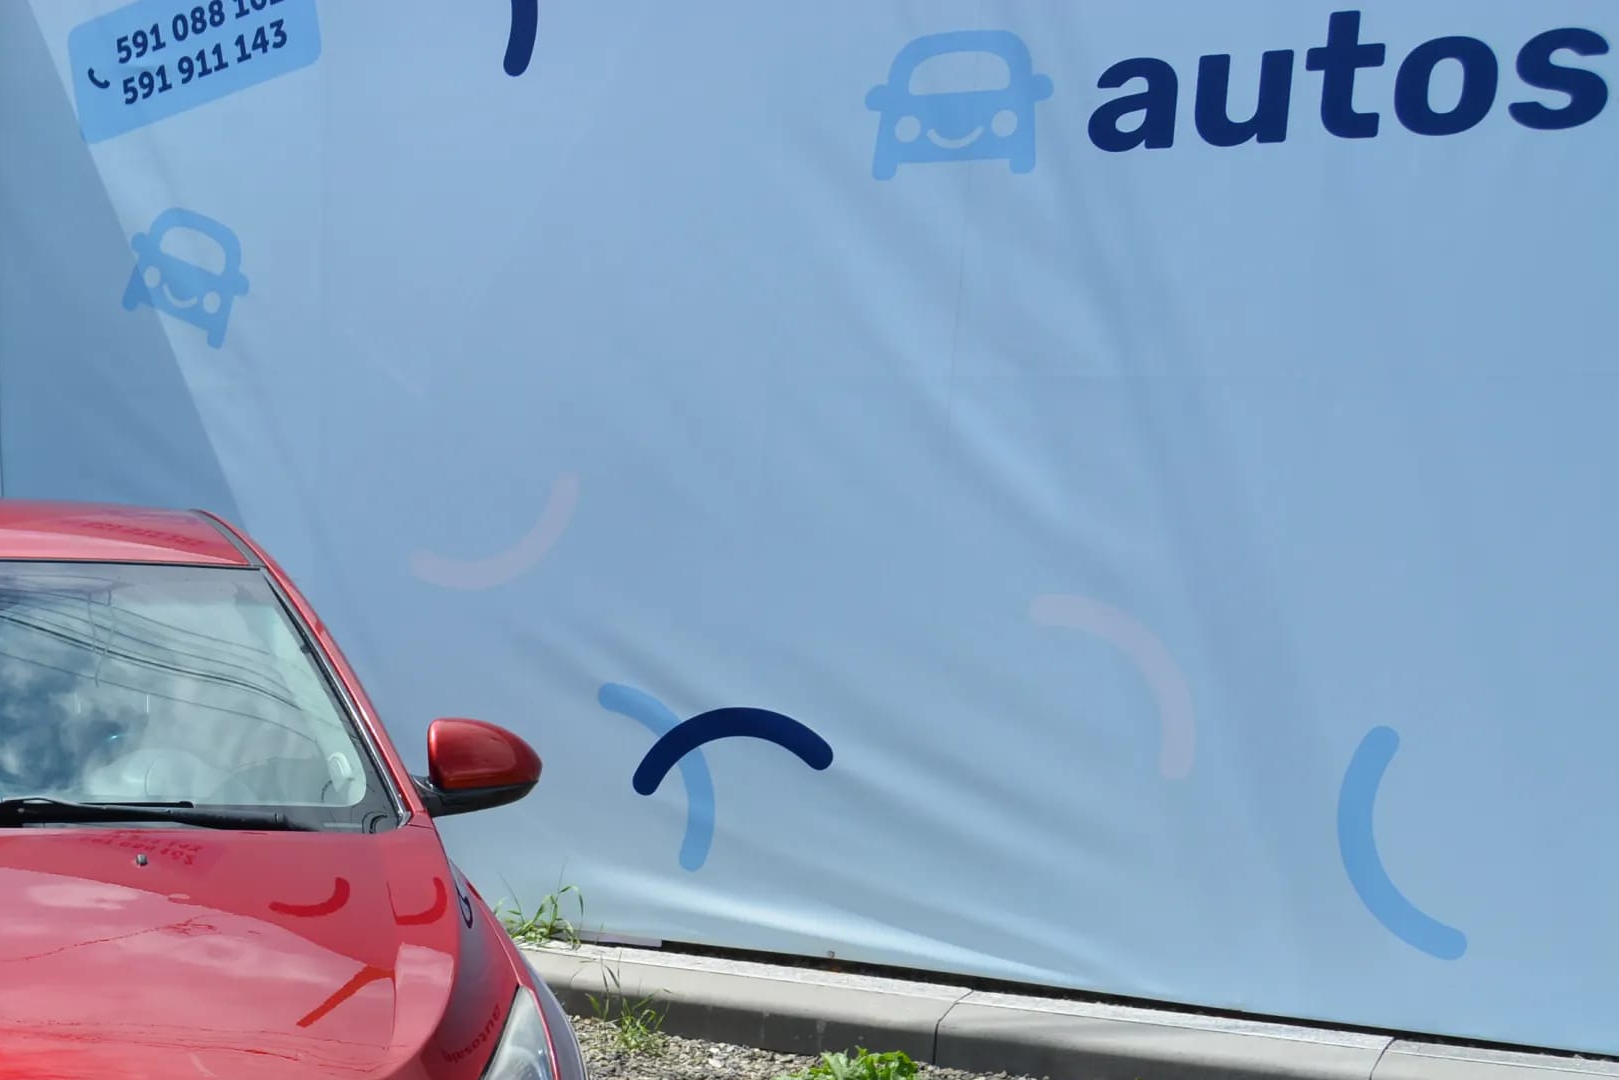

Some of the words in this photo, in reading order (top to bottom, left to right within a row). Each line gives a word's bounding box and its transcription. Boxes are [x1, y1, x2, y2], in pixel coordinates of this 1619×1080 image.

[116, 23, 166, 64] 591
[172, 0, 225, 42] 088
[123, 64, 172, 105] 591
[178, 43, 229, 84] 911
[234, 19, 287, 63] 143
[1087, 10, 1610, 153] autos
